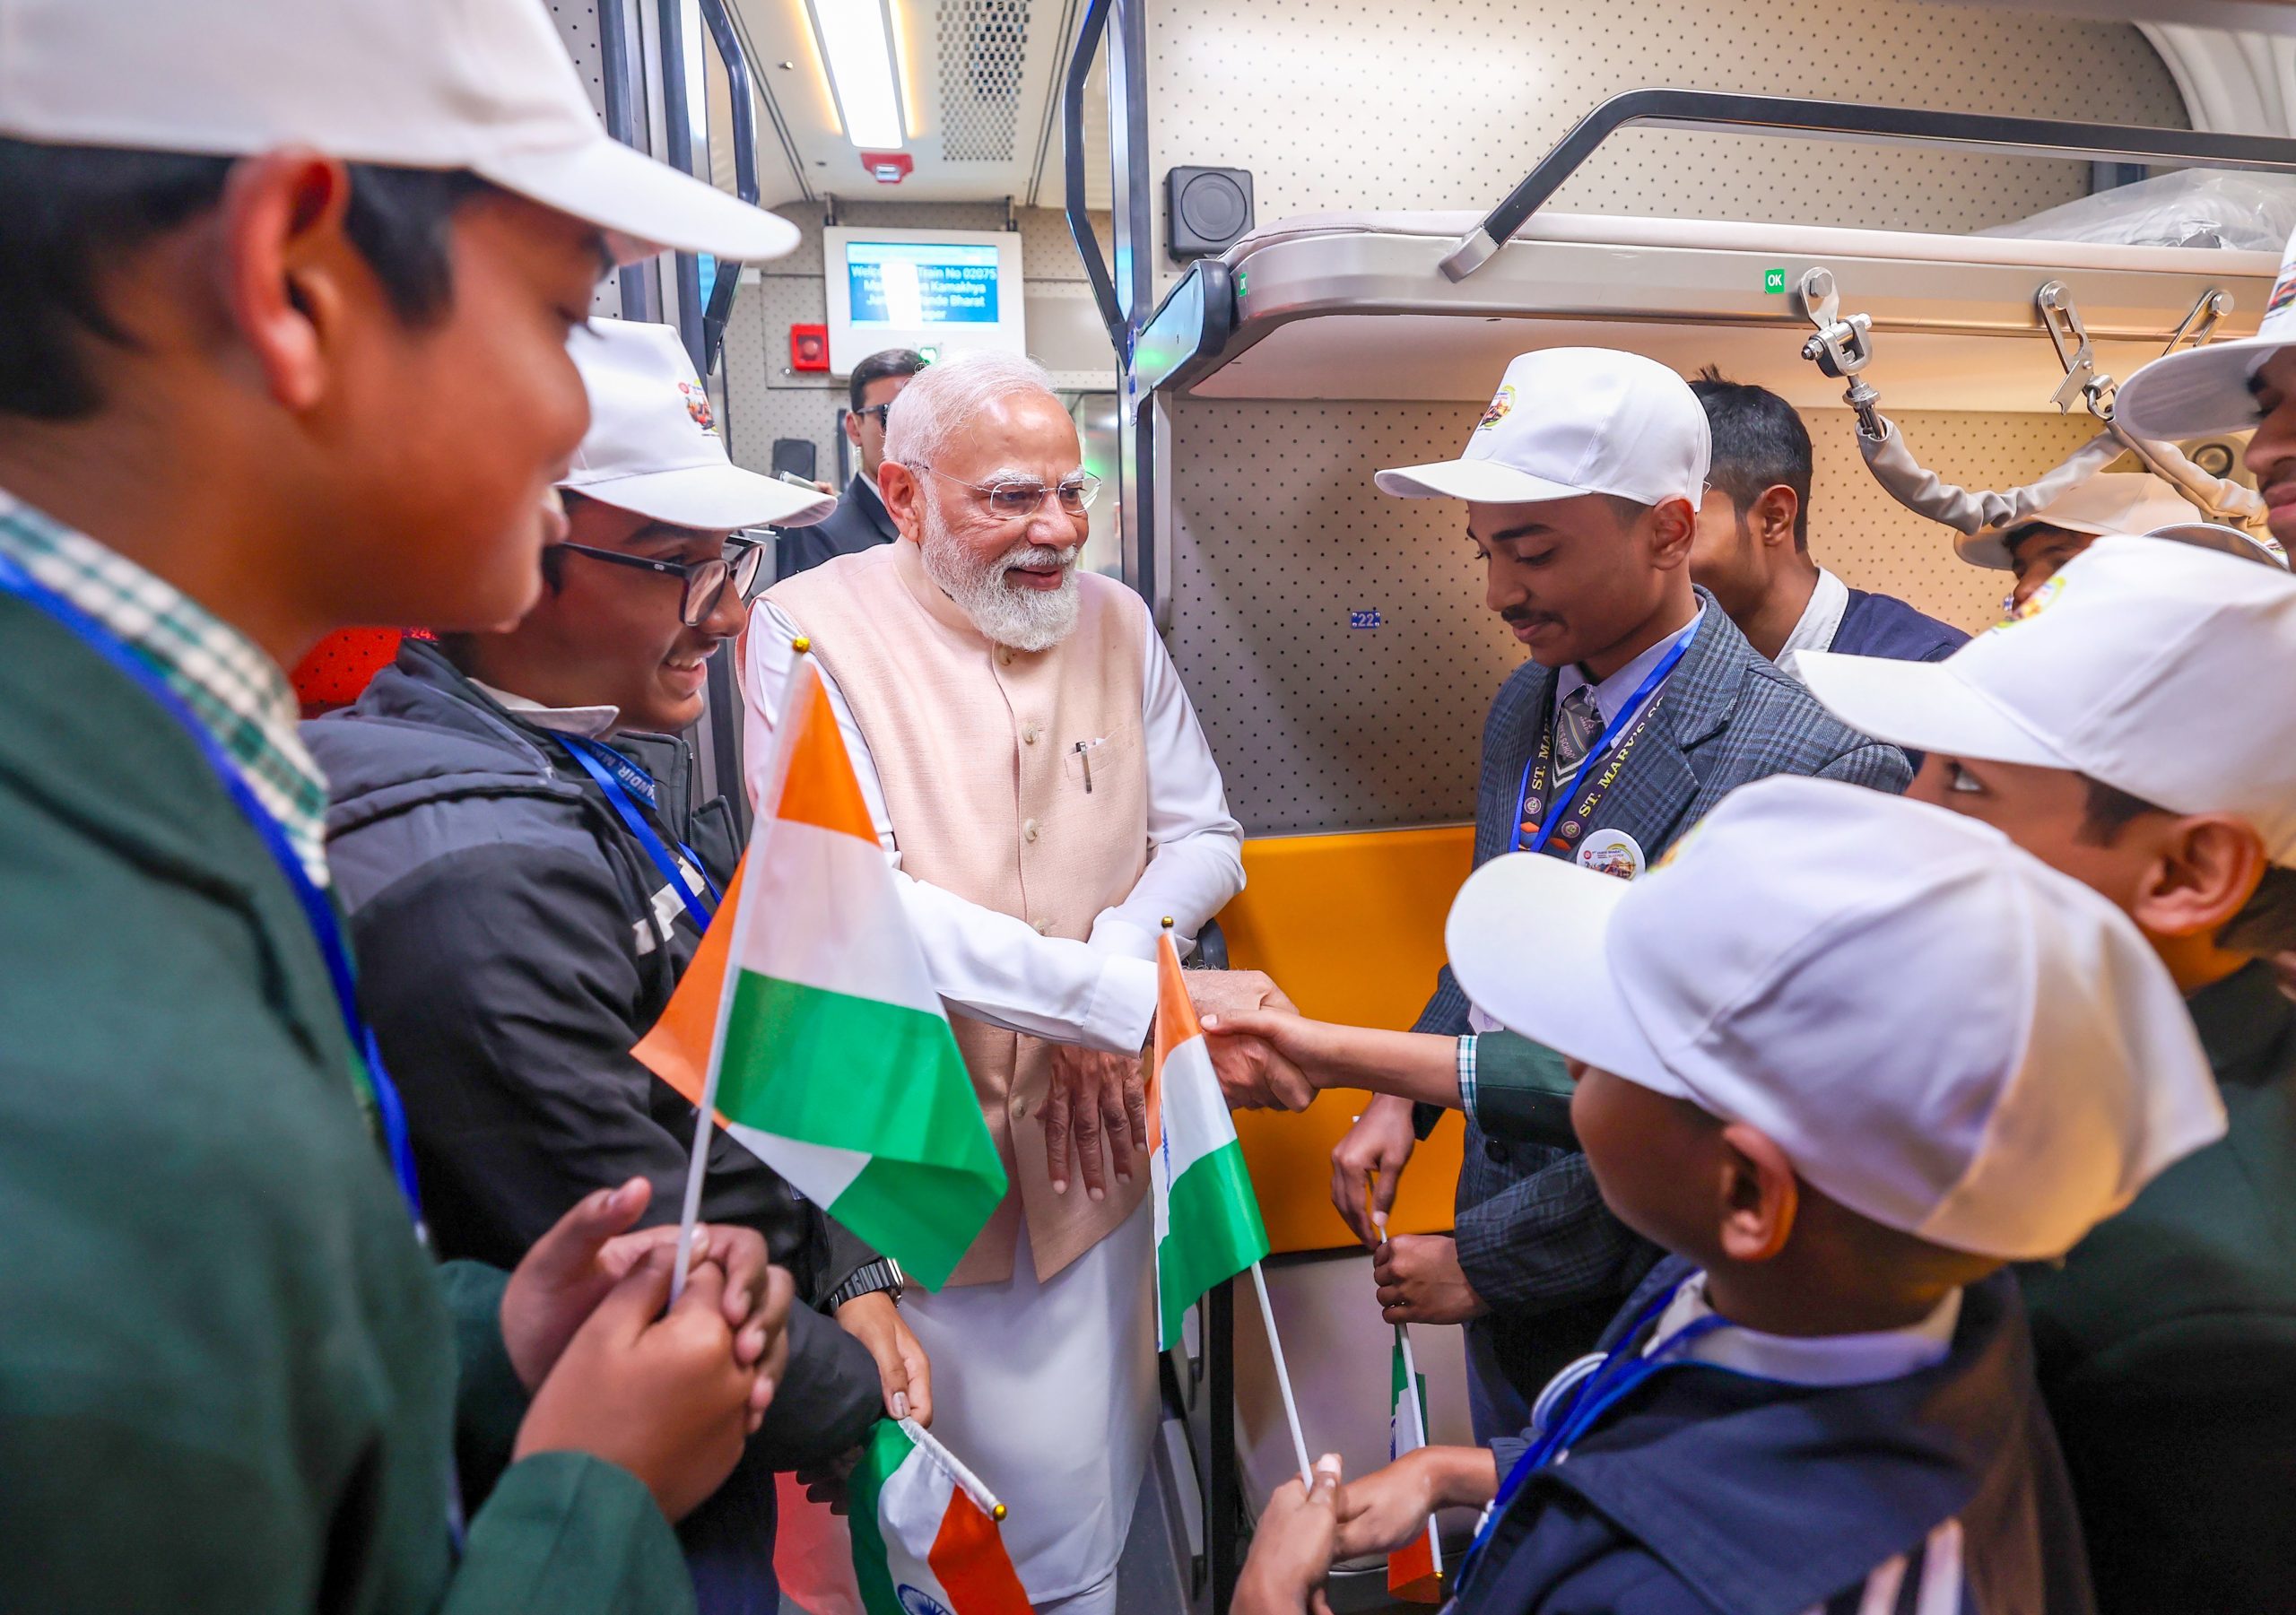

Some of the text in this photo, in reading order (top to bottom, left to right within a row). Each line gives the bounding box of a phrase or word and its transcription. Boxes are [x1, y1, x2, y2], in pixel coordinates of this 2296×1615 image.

[944, 267, 961, 280] No
[1768, 274, 1782, 286] OK
[950, 294, 986, 308] Bharat
[1358, 612, 1375, 627] 22
[1531, 765, 1547, 791] ST.
[1578, 792, 1602, 818] ST.
